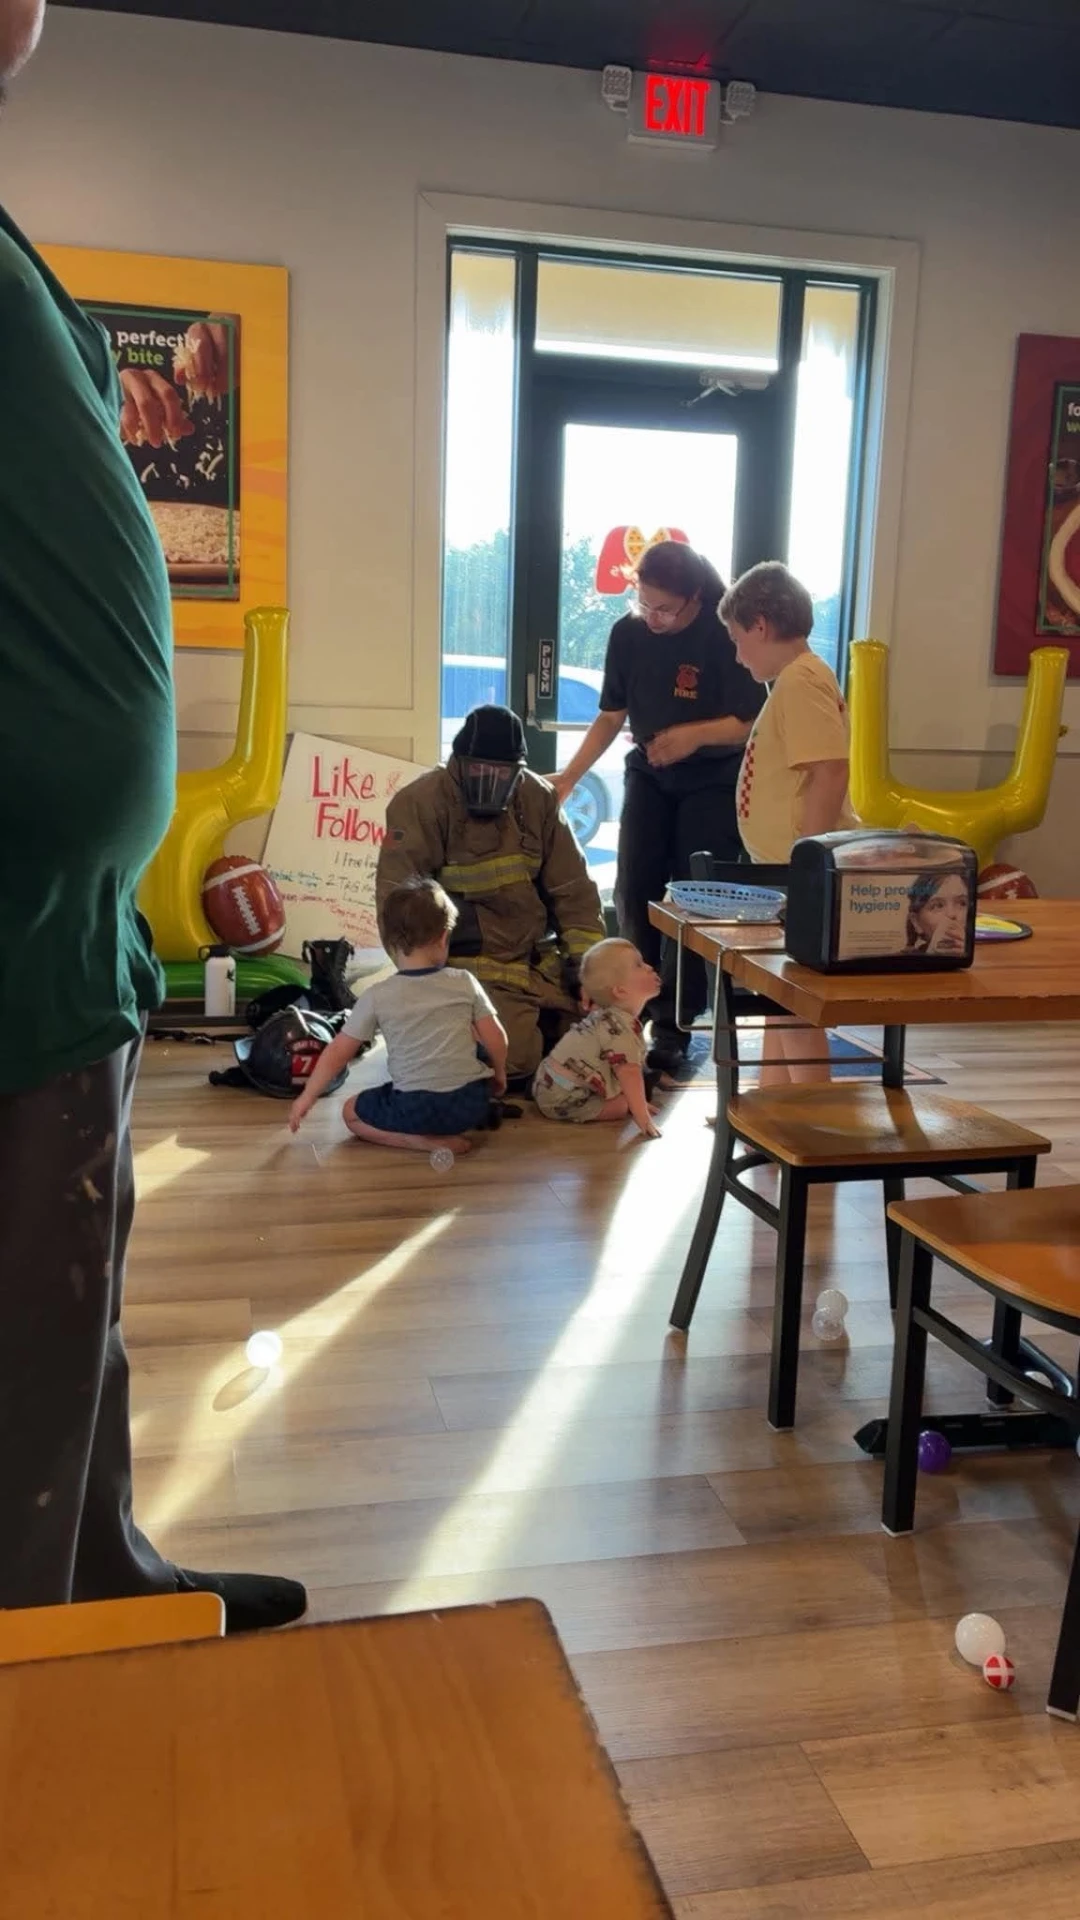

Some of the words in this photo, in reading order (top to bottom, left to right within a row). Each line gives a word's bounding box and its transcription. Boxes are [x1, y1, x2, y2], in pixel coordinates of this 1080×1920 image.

[645, 73, 711, 136] EXIT
[117, 330, 201, 350] perfectly
[128, 348, 163, 365] bite
[541, 645, 551, 692] PUSH
[313, 756, 375, 799] Like
[316, 802, 385, 846] Follow
[851, 884, 881, 897] Help
[850, 901, 900, 913] hygiene
[301, 1056, 312, 1073] 7
